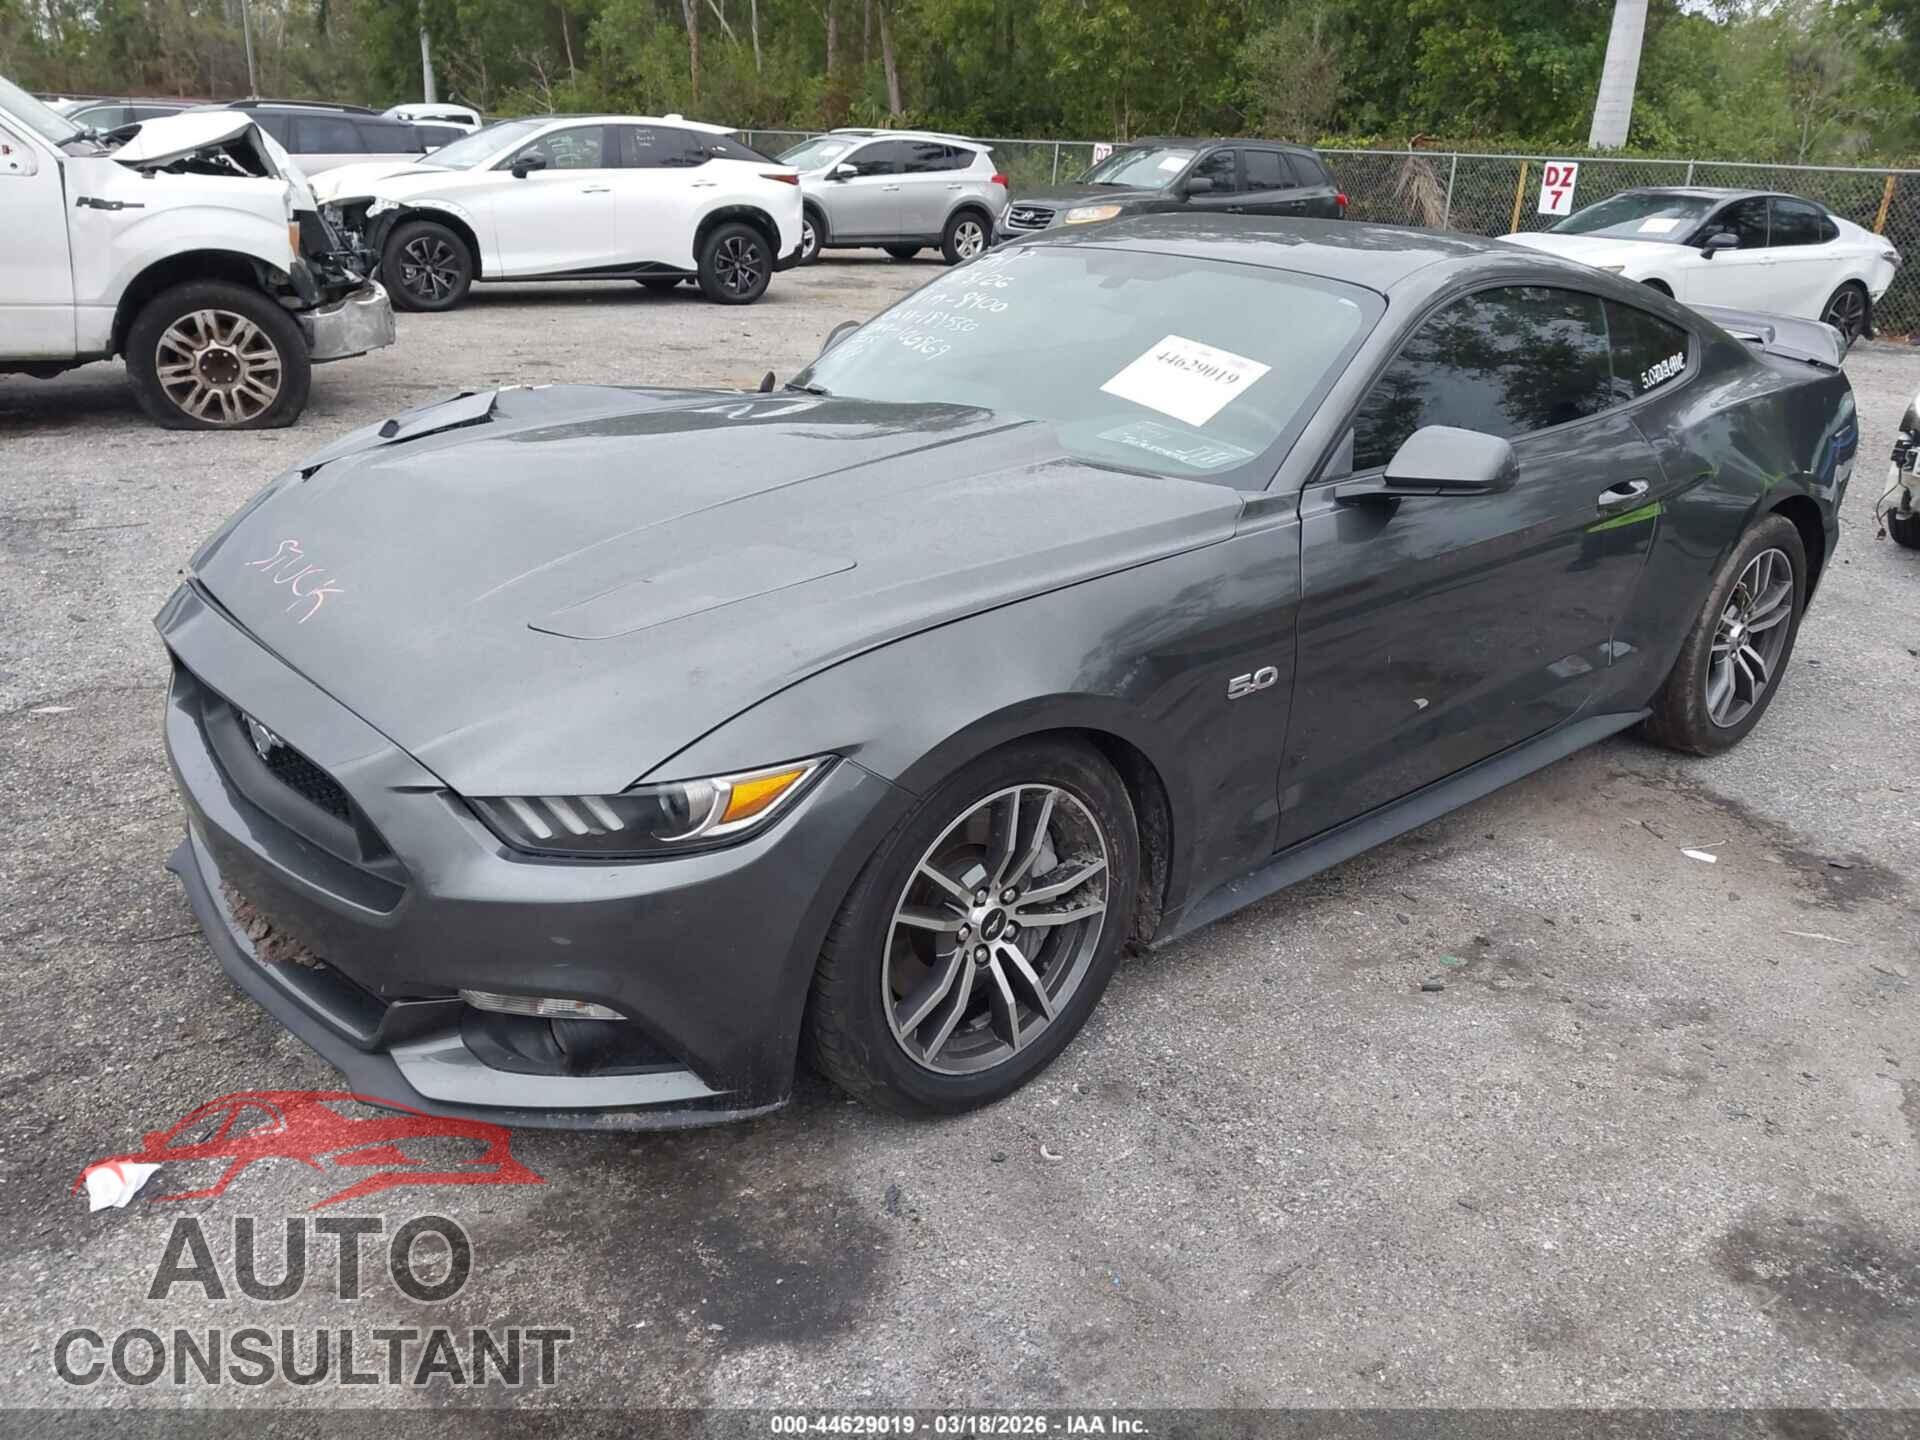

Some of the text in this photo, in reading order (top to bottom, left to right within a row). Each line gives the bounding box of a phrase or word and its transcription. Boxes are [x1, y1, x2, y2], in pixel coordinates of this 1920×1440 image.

[1545, 166, 1575, 187] DZ
[1551, 190, 1563, 209] 7
[1156, 351, 1240, 385] 44629019
[1227, 665, 1279, 700] 5.0
